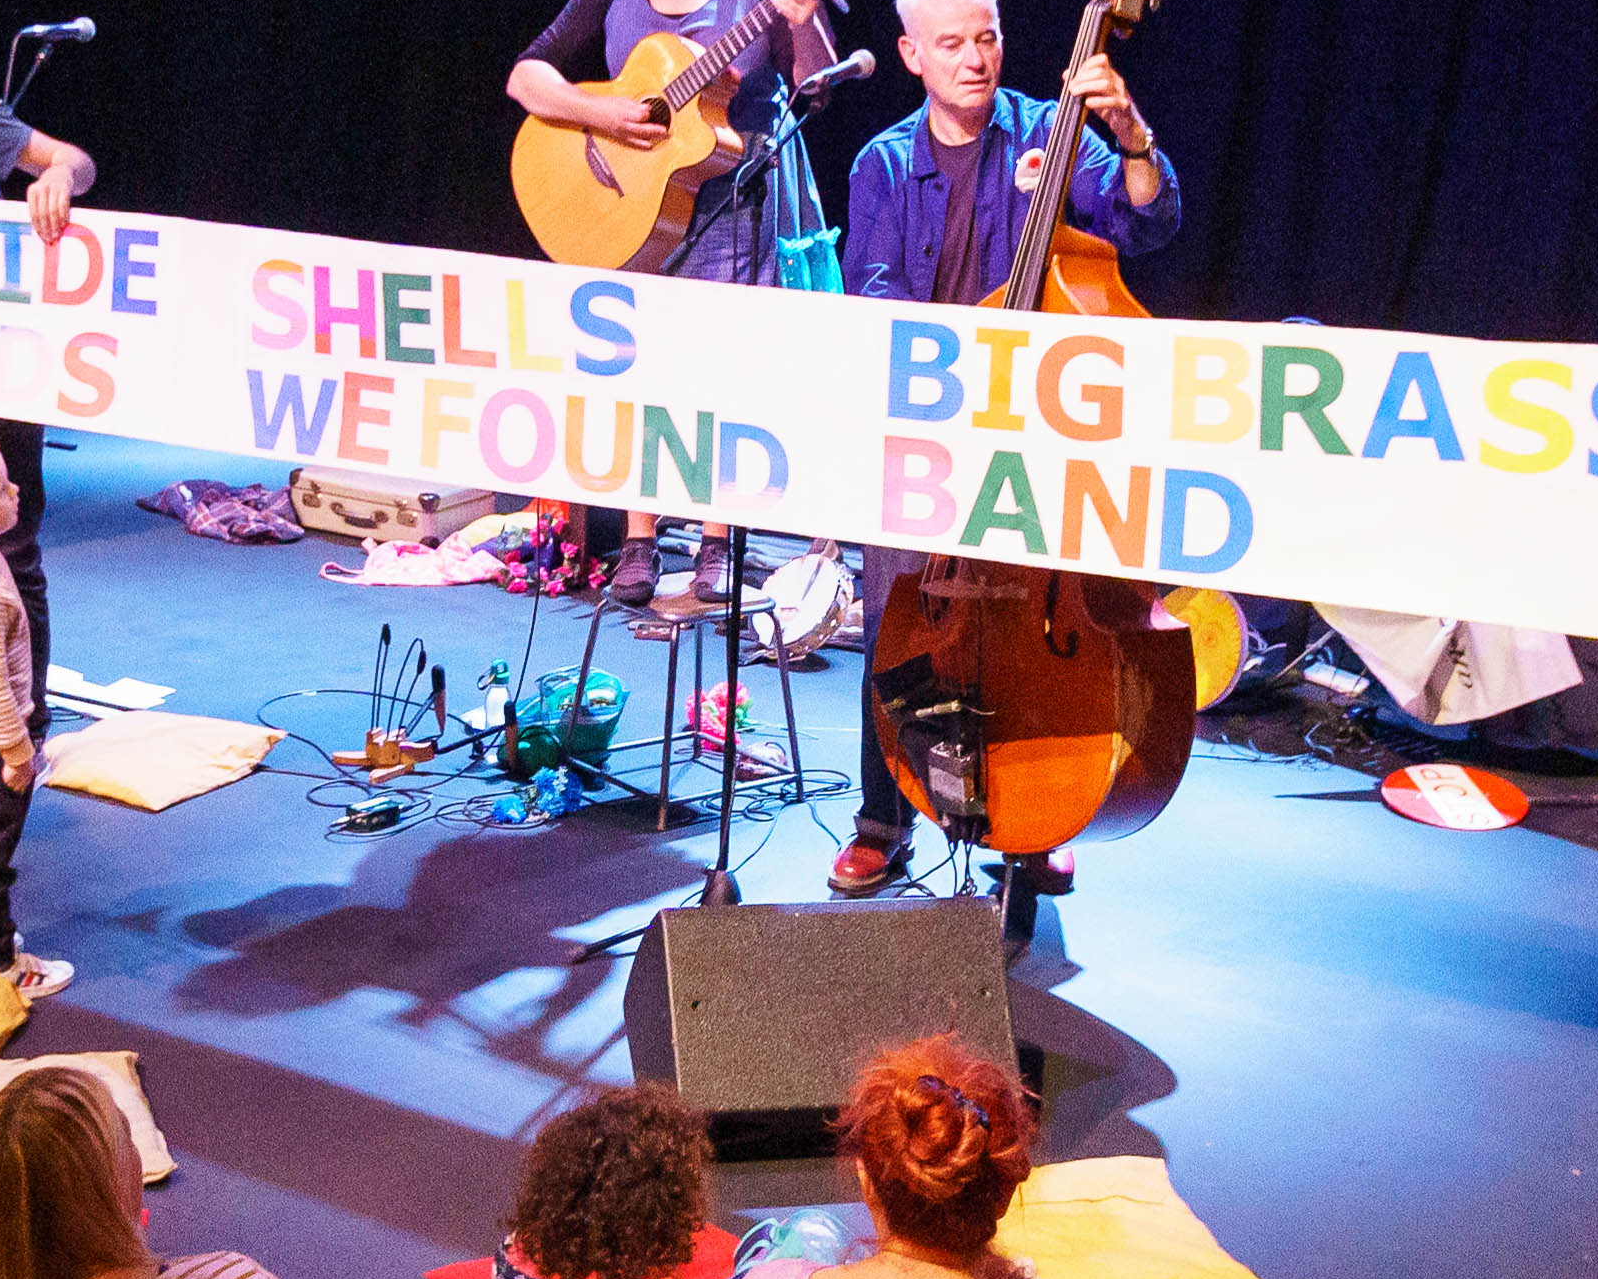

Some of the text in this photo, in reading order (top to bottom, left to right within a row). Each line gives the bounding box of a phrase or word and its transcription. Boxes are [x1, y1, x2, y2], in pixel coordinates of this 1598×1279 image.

[251, 258, 636, 378] SHELLS
[887, 319, 1126, 443] BIG
[246, 369, 789, 511] WE FOUND
[881, 434, 1255, 575] BAND
